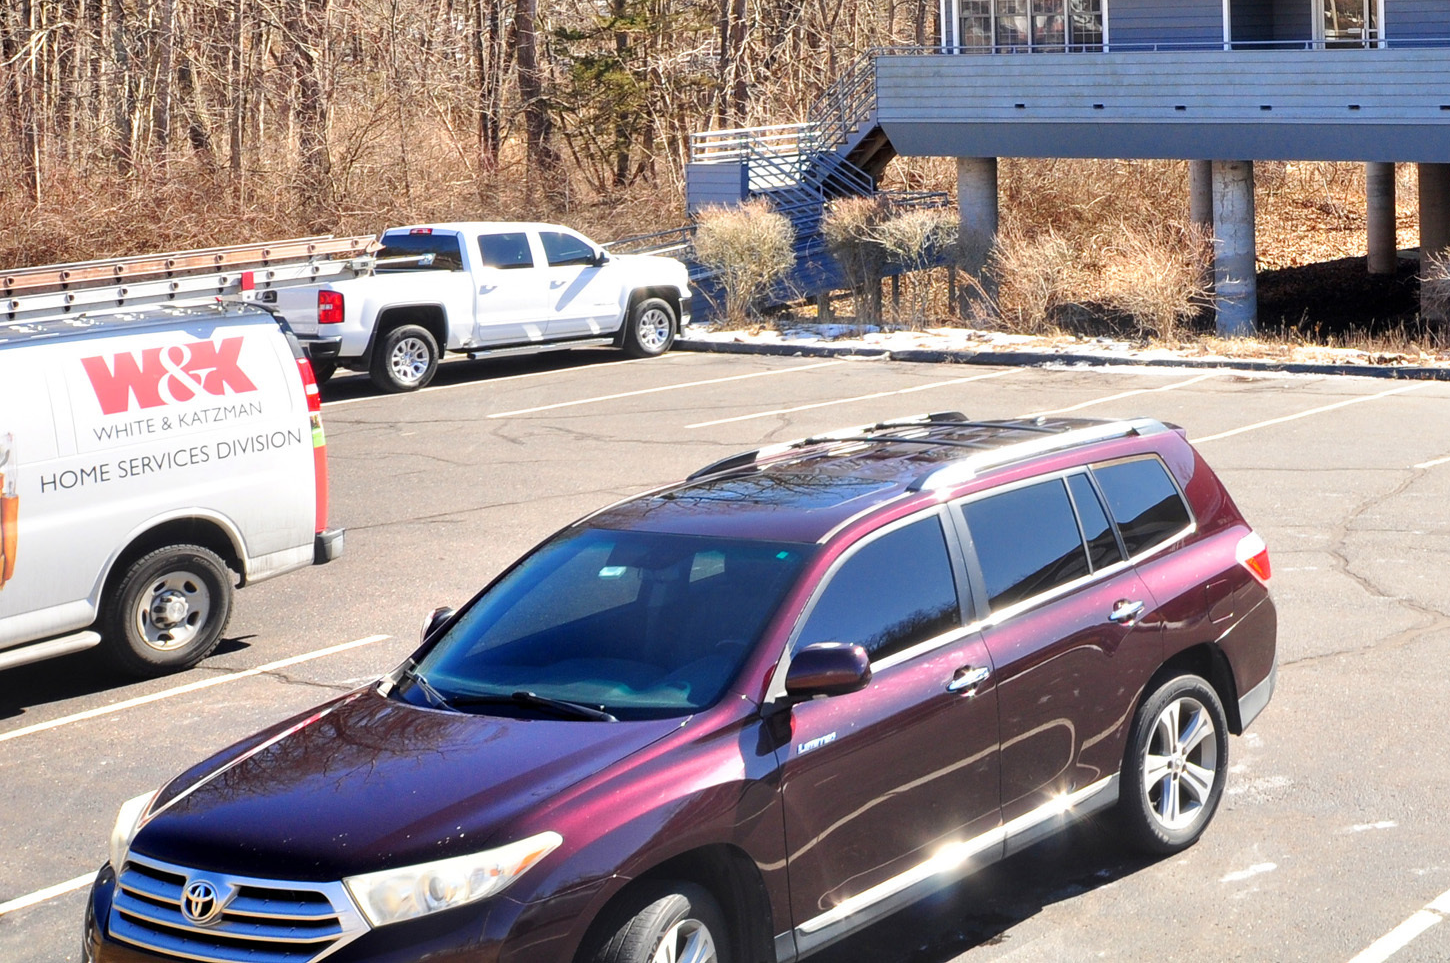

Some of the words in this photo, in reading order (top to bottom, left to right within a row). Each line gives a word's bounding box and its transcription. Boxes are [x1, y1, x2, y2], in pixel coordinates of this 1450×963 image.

[80, 336, 259, 415] W&K
[93, 417, 156, 441] WHITE
[161, 416, 173, 431] &
[178, 401, 263, 428] KATZMAN
[40, 463, 111, 493] HOME
[117, 445, 210, 479] SERVICES
[216, 428, 302, 460] DIVISION
